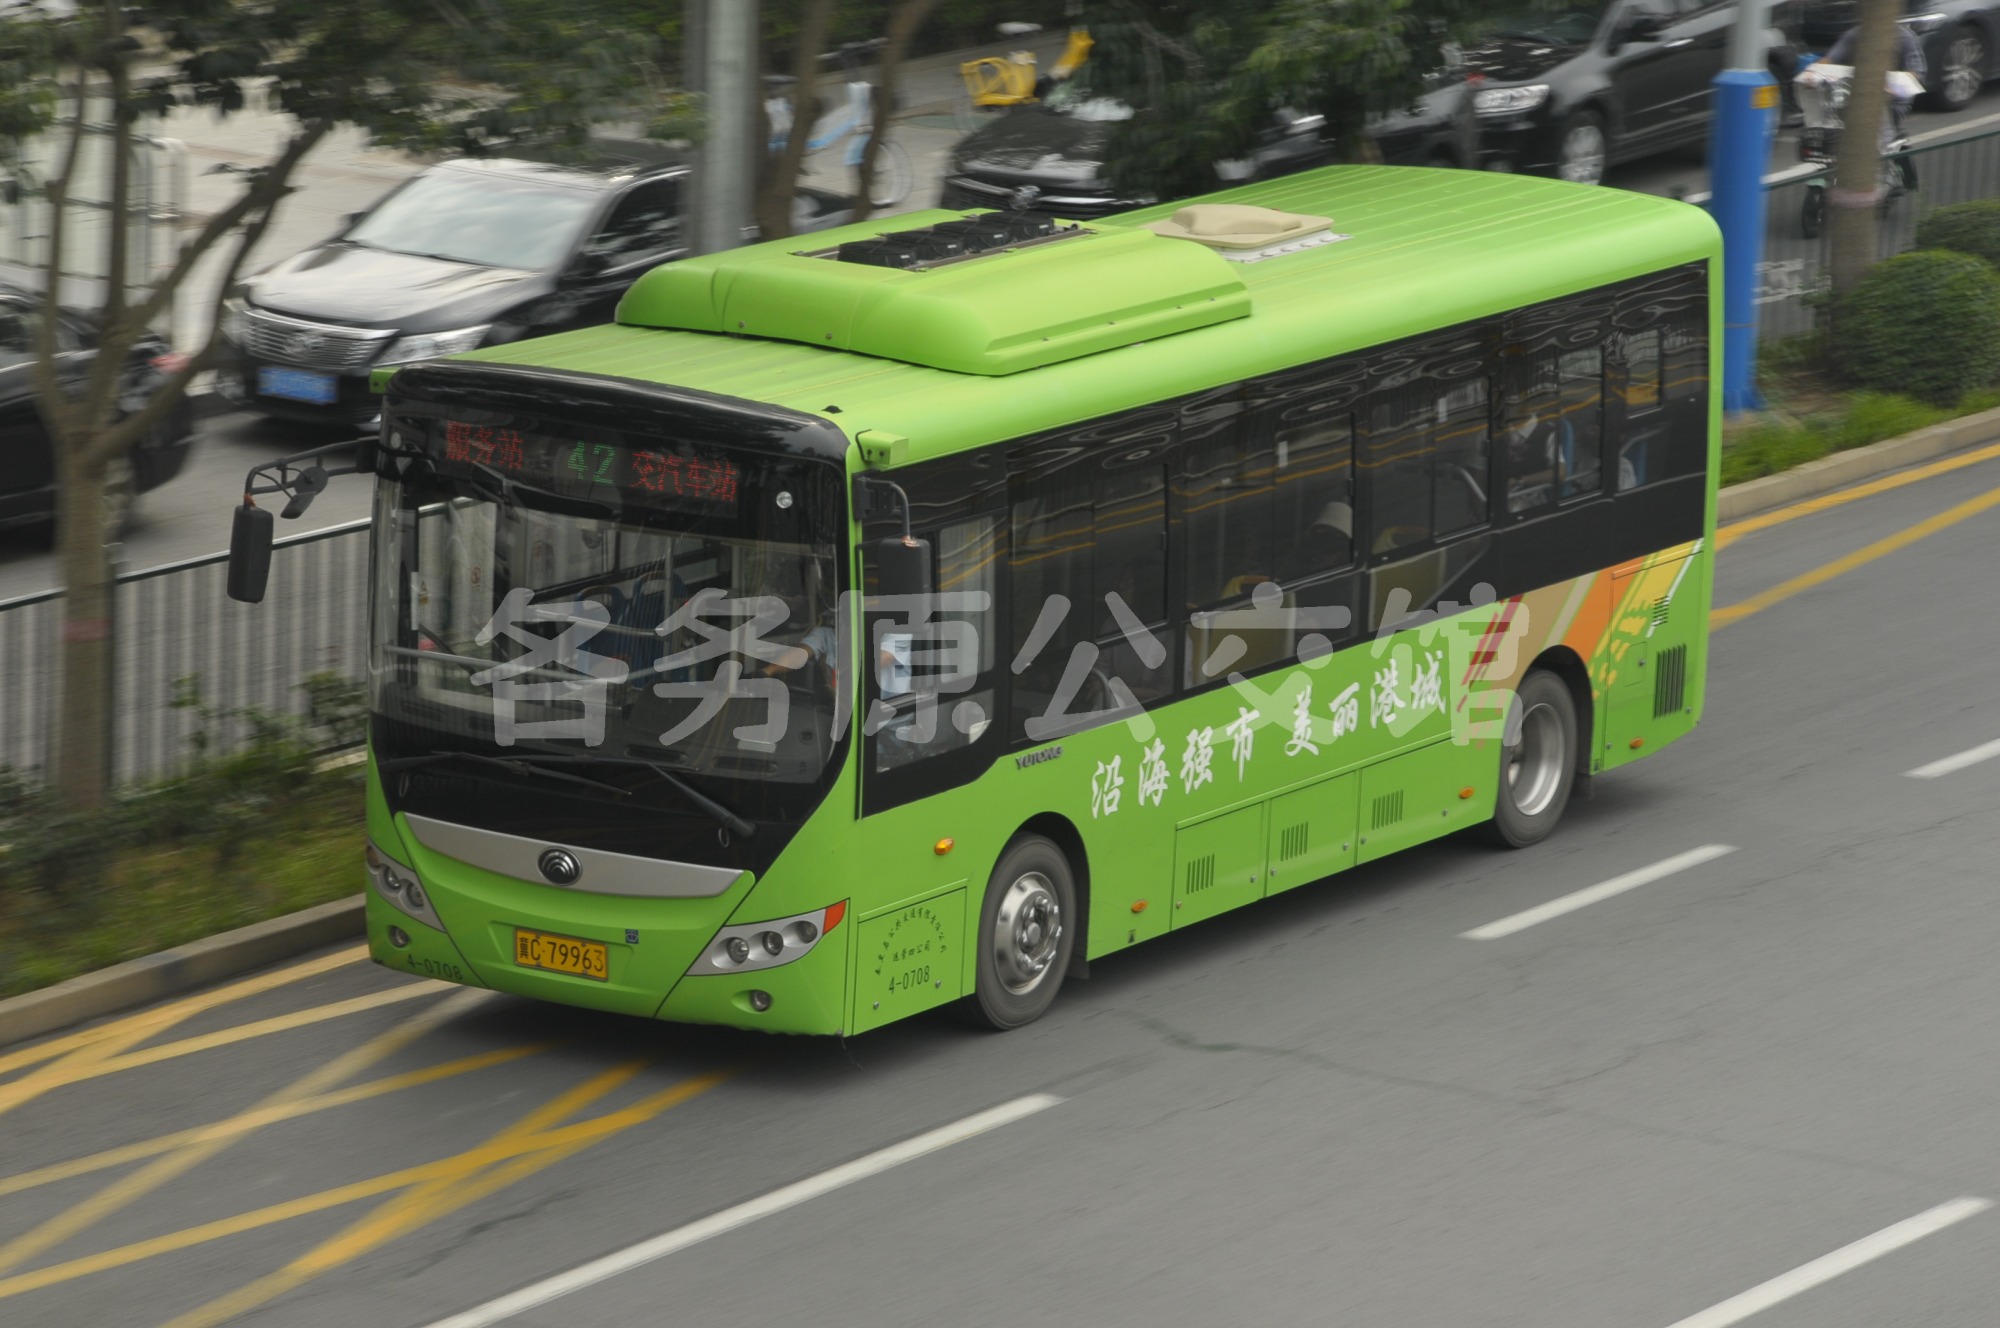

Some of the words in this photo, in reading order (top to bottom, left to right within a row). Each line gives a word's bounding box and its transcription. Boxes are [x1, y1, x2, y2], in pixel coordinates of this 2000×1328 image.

[567, 440, 616, 484] 42
[1091, 707, 1261, 819] 沿海强市
[1284, 650, 1447, 757] 美丽港城
[1015, 746, 1063, 770] YUTONG
[407, 953, 463, 980] 4-0708
[888, 965, 931, 995] 4-0708
